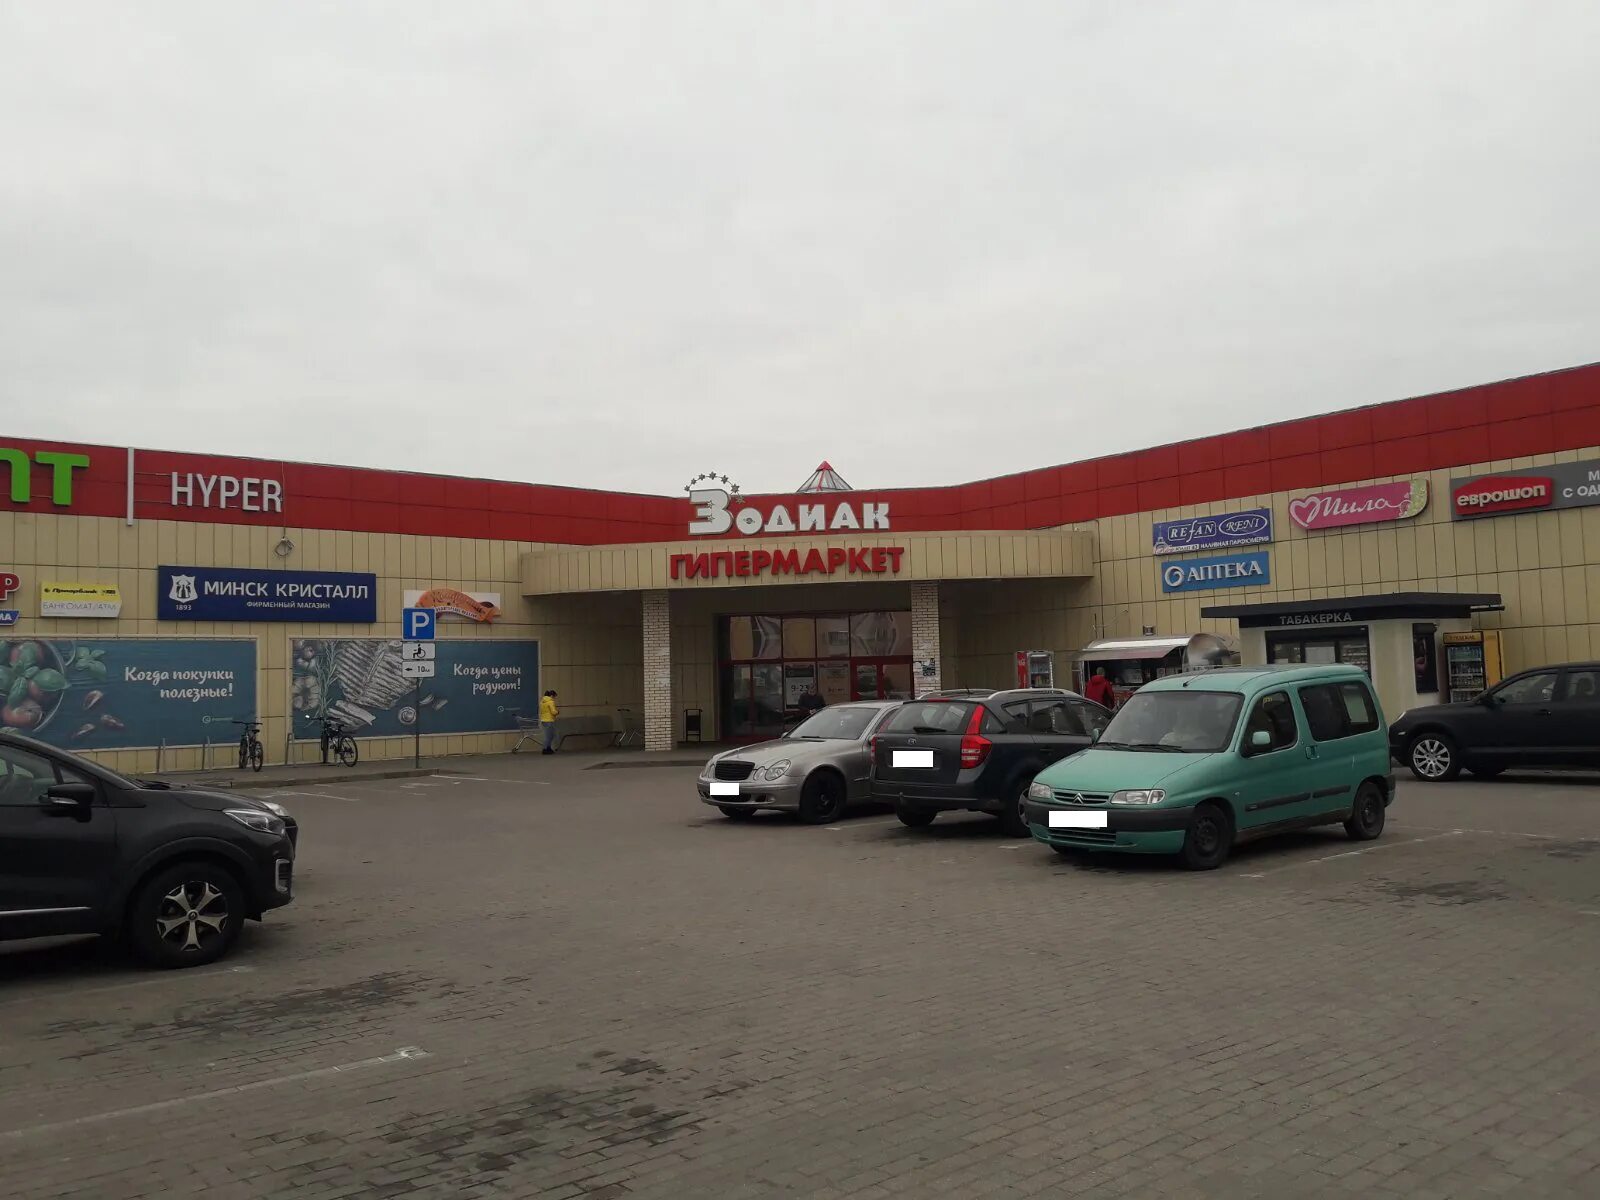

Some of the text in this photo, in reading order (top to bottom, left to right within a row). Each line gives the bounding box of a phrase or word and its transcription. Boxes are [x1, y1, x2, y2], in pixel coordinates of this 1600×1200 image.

[171, 471, 282, 512] HYPER
[1457, 485, 1546, 507] еврошоп
[1225, 518, 1260, 533] RENI
[670, 547, 905, 579] ГИПЕРМАРКЕТ
[1187, 560, 1263, 582] АПТЕКА
[204, 580, 369, 599] МИНСК КРИСТАЛЛ
[412, 612, 430, 637] P
[1280, 611, 1353, 626] ТАБАКЕРКА
[125, 667, 234, 686] Когда покупки
[453, 663, 521, 679] Когда цены
[160, 683, 233, 702] полезные!
[472, 678, 521, 695] радуют!
